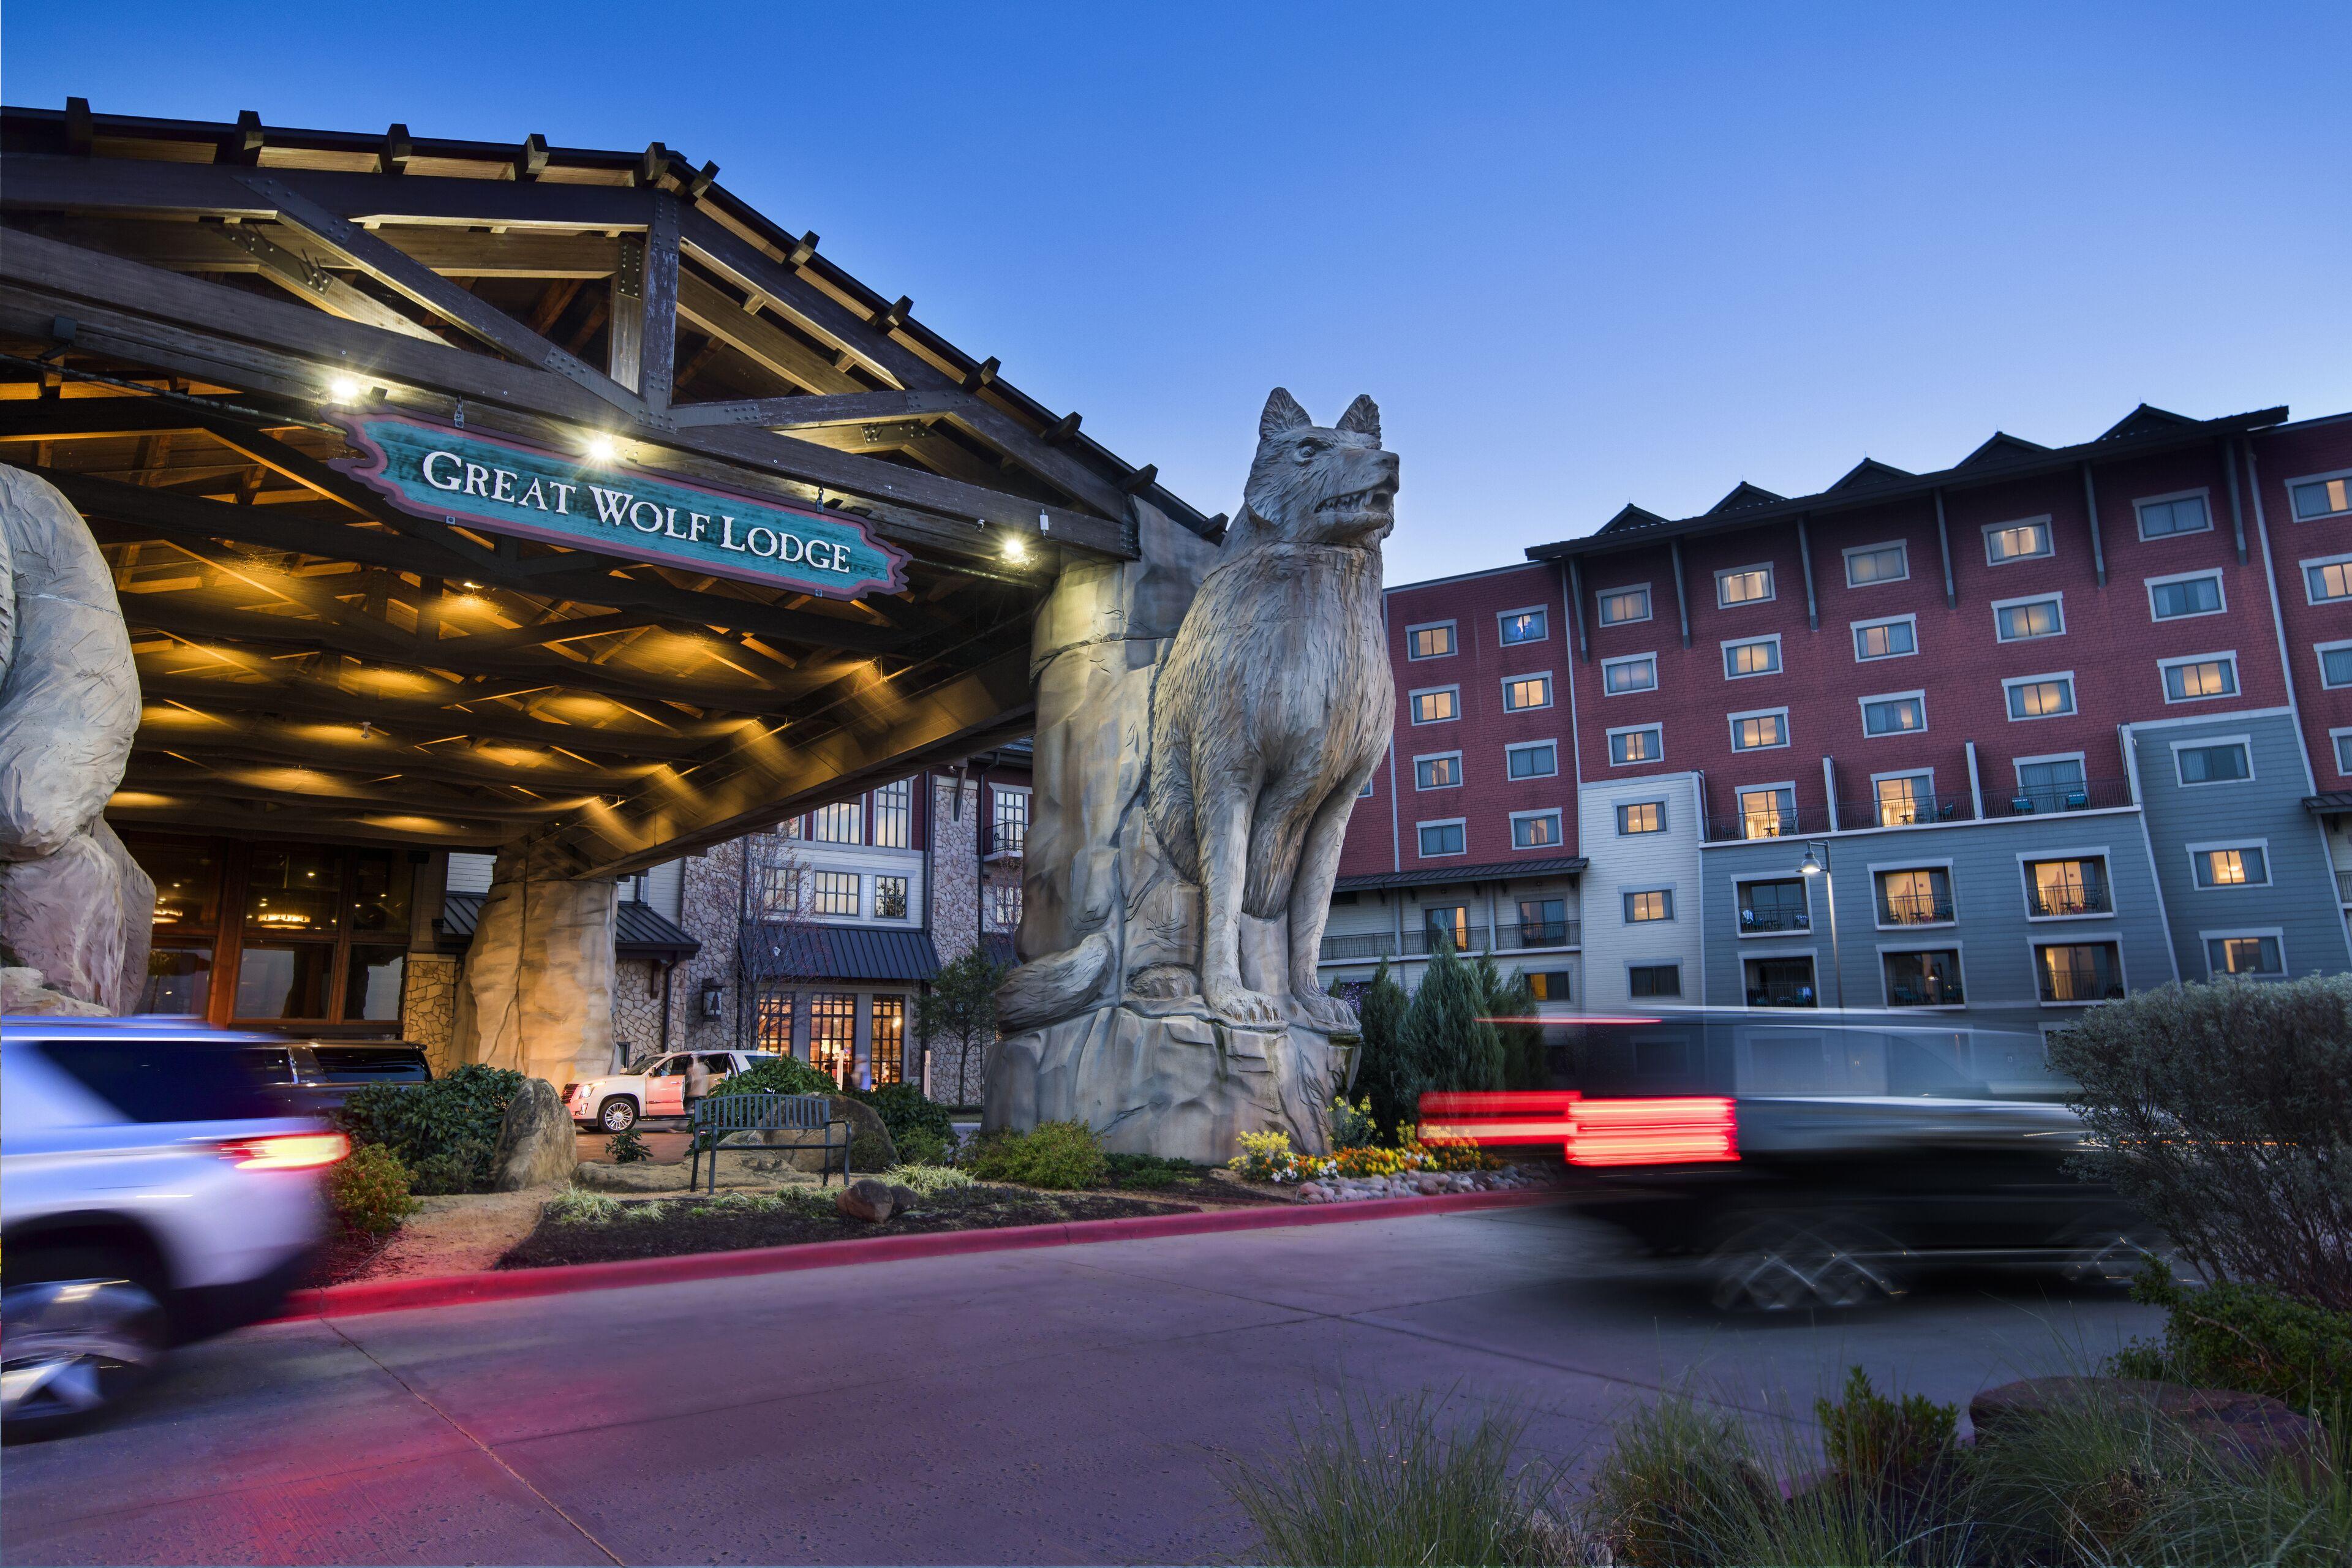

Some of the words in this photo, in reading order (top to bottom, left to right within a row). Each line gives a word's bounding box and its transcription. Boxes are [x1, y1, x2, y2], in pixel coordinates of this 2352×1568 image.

[423, 451, 576, 514] GREAT
[589, 485, 710, 542] WOLF
[720, 515, 851, 573] LODGE
